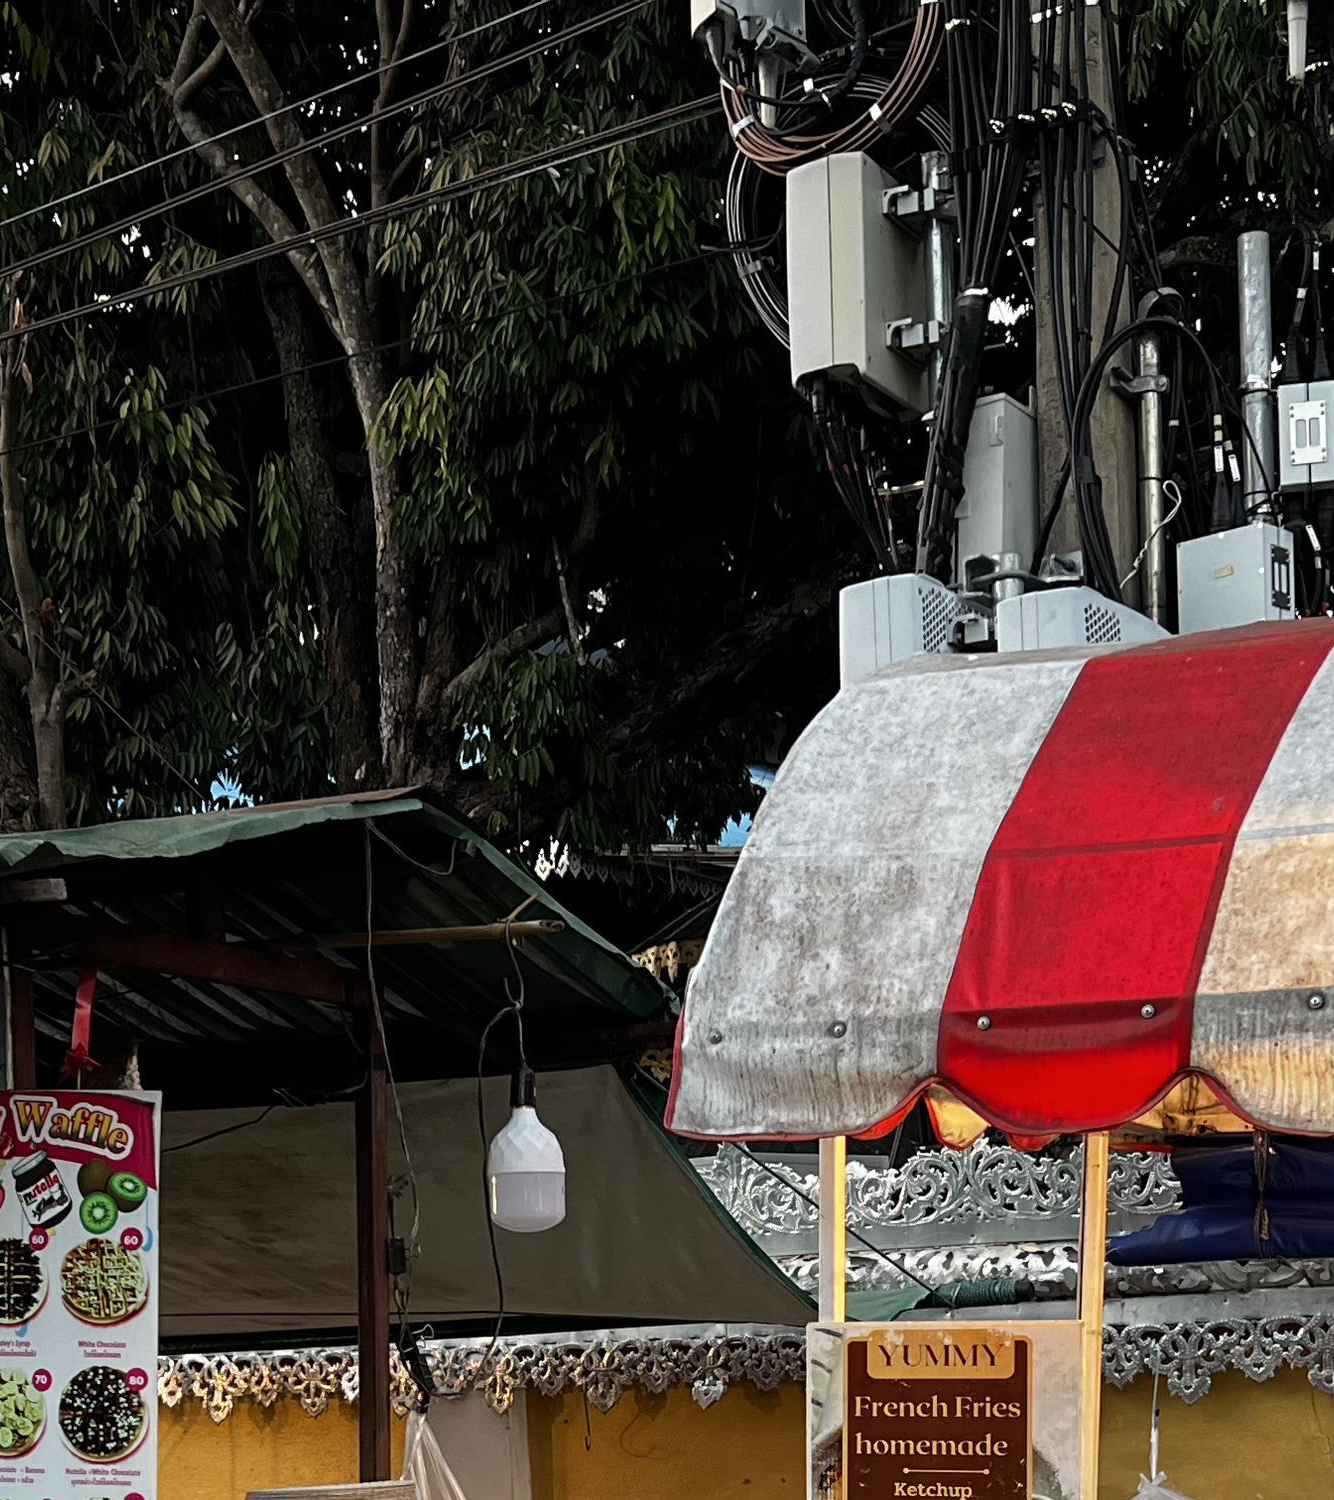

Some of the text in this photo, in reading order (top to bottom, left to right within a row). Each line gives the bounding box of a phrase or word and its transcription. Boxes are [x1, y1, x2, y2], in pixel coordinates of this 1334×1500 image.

[13, 1096, 132, 1158] Waffle
[31, 1235, 45, 1244] 60
[123, 1235, 138, 1245] 60
[878, 1343, 1006, 1368] YUMMY
[35, 1375, 48, 1385] 70
[854, 1395, 1022, 1419] French Fries
[855, 1433, 1009, 1458] homemade
[893, 1482, 973, 1500] Ketchup
